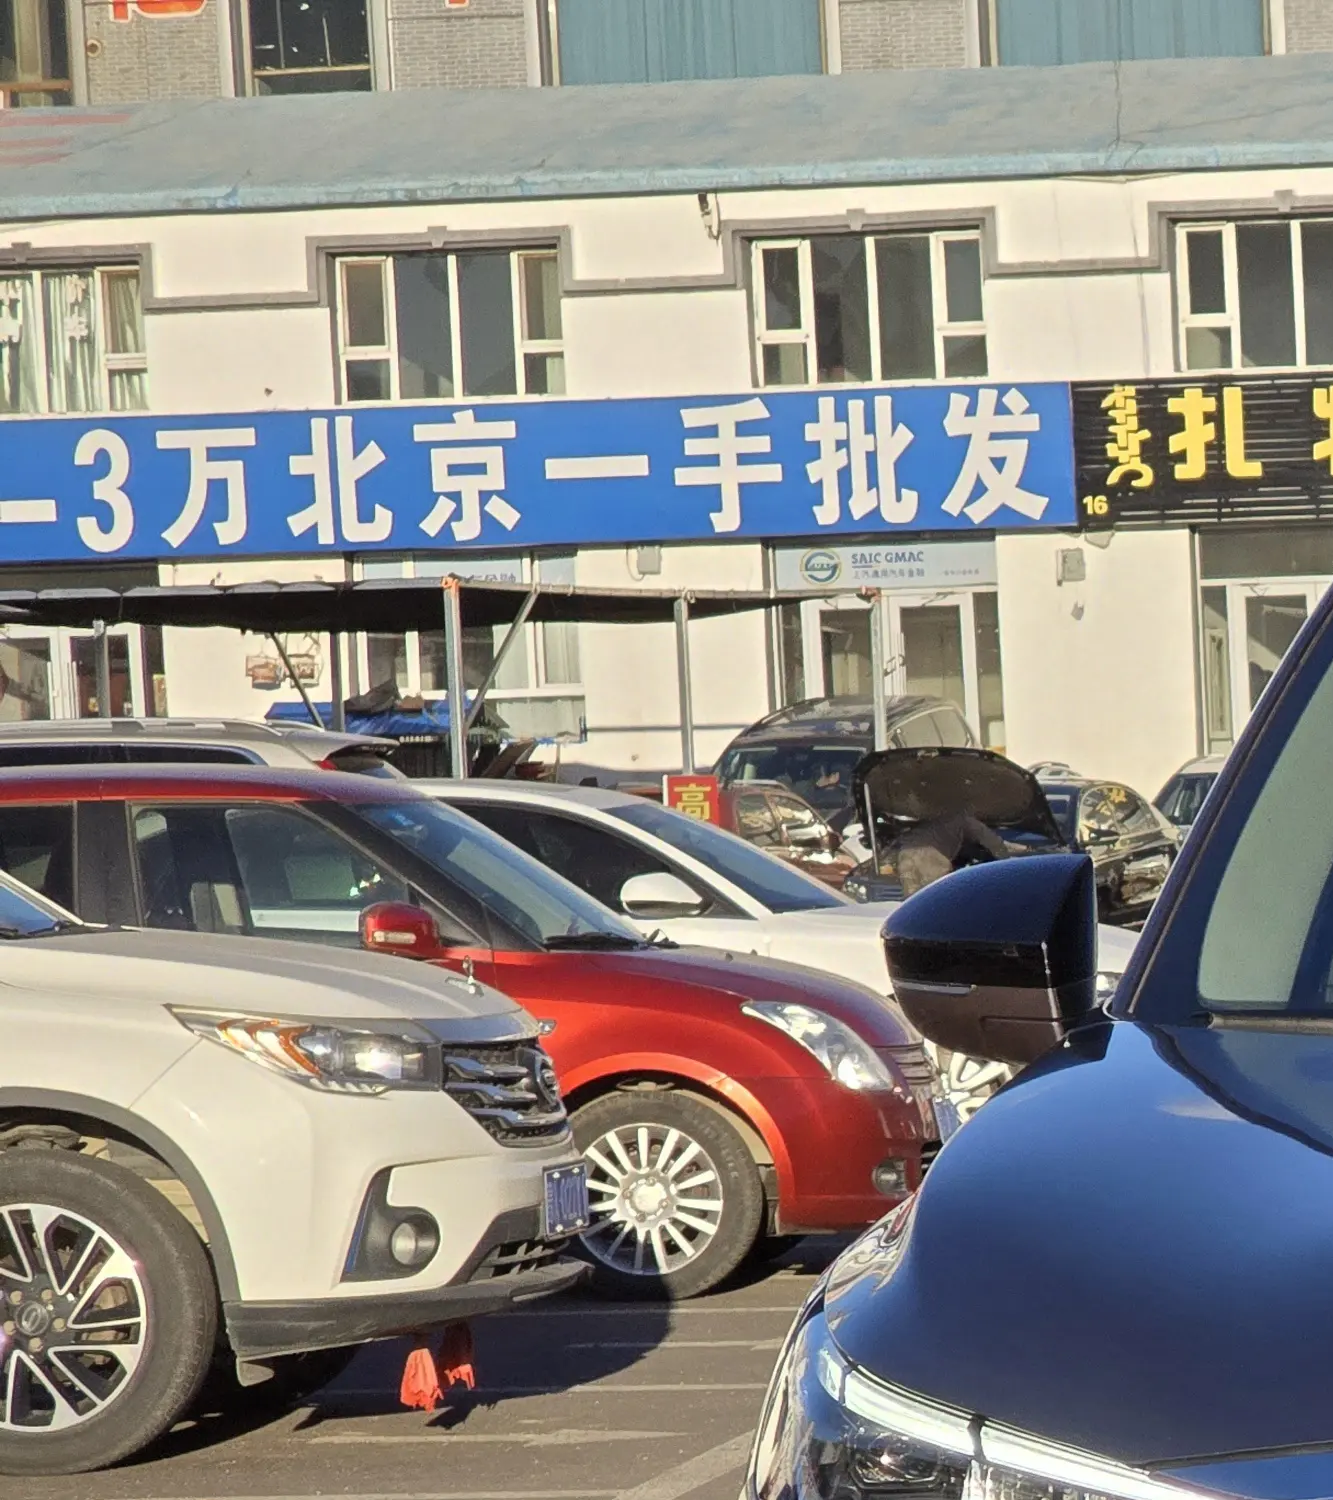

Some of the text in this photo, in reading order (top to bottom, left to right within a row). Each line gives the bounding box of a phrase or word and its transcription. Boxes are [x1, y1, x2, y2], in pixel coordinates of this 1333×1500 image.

[1082, 495, 1109, 515] 16
[851, 550, 925, 564] SAIC GMAC
[673, 783, 713, 821] 高
